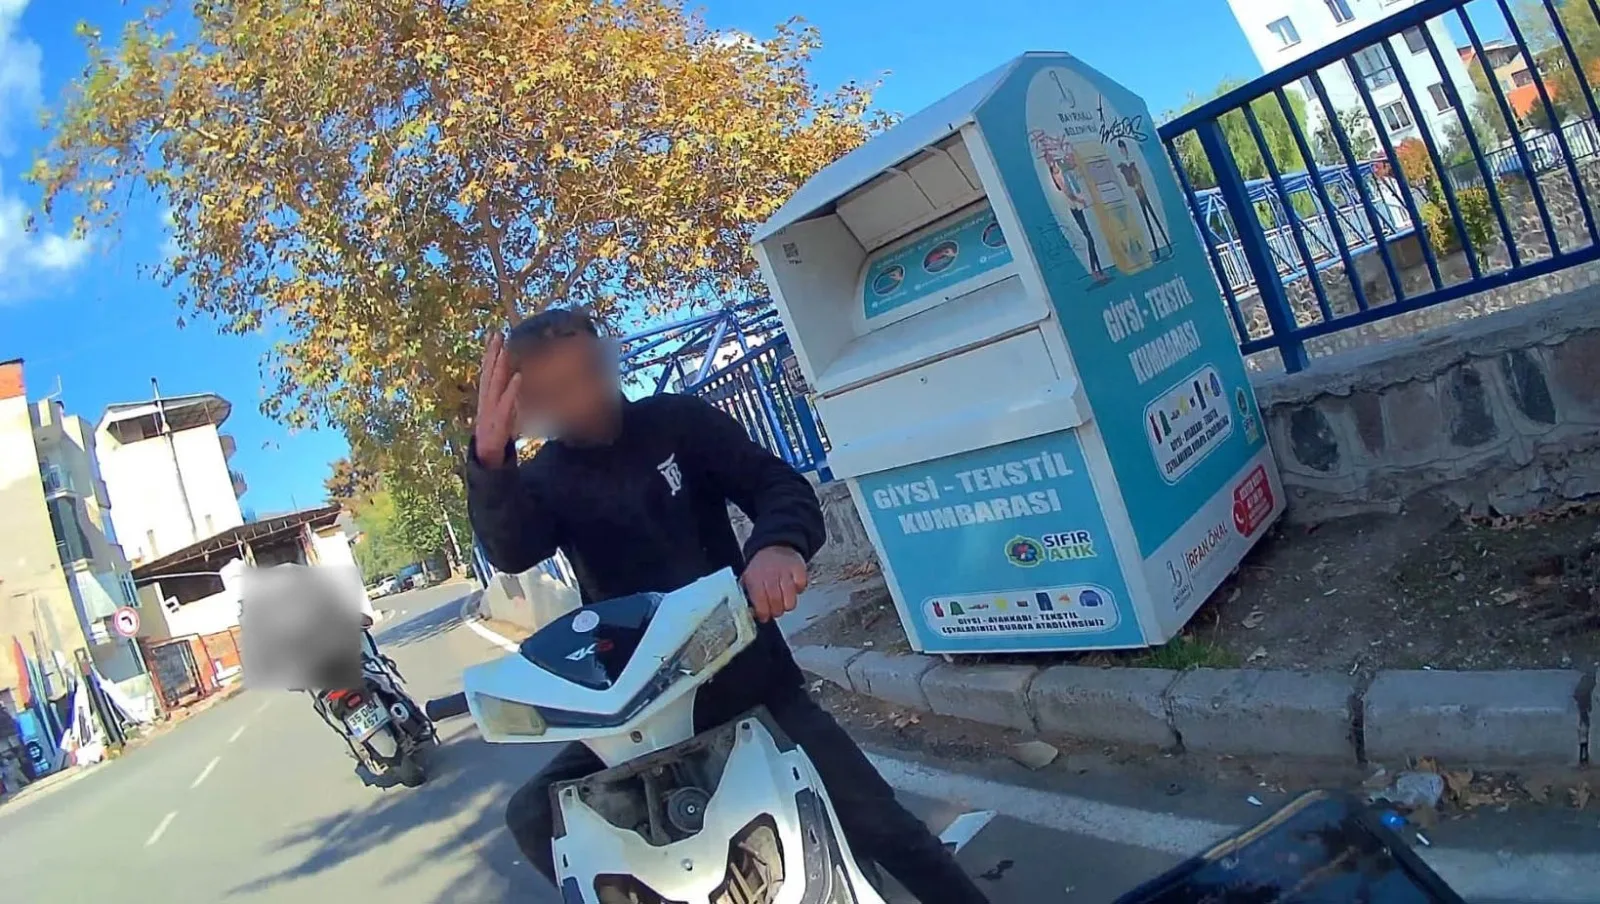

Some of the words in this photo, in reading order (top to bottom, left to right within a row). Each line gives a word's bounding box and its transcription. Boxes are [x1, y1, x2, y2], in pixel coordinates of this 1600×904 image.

[1103, 291, 1145, 343] GİYSİ
[1144, 273, 1193, 322] TEKSTİL
[1128, 319, 1201, 385] KUMBARASI
[872, 475, 940, 510] GİYSİ
[954, 451, 1074, 493] TEKSTİL
[898, 488, 1062, 535] KUMBARASI
[1043, 531, 1090, 547] SIFIR
[1049, 544, 1096, 560] ATIK
[988, 614, 1032, 623] AYAKKABI
[998, 623, 1034, 631] BURAYA
[350, 713, 361, 726] 35
